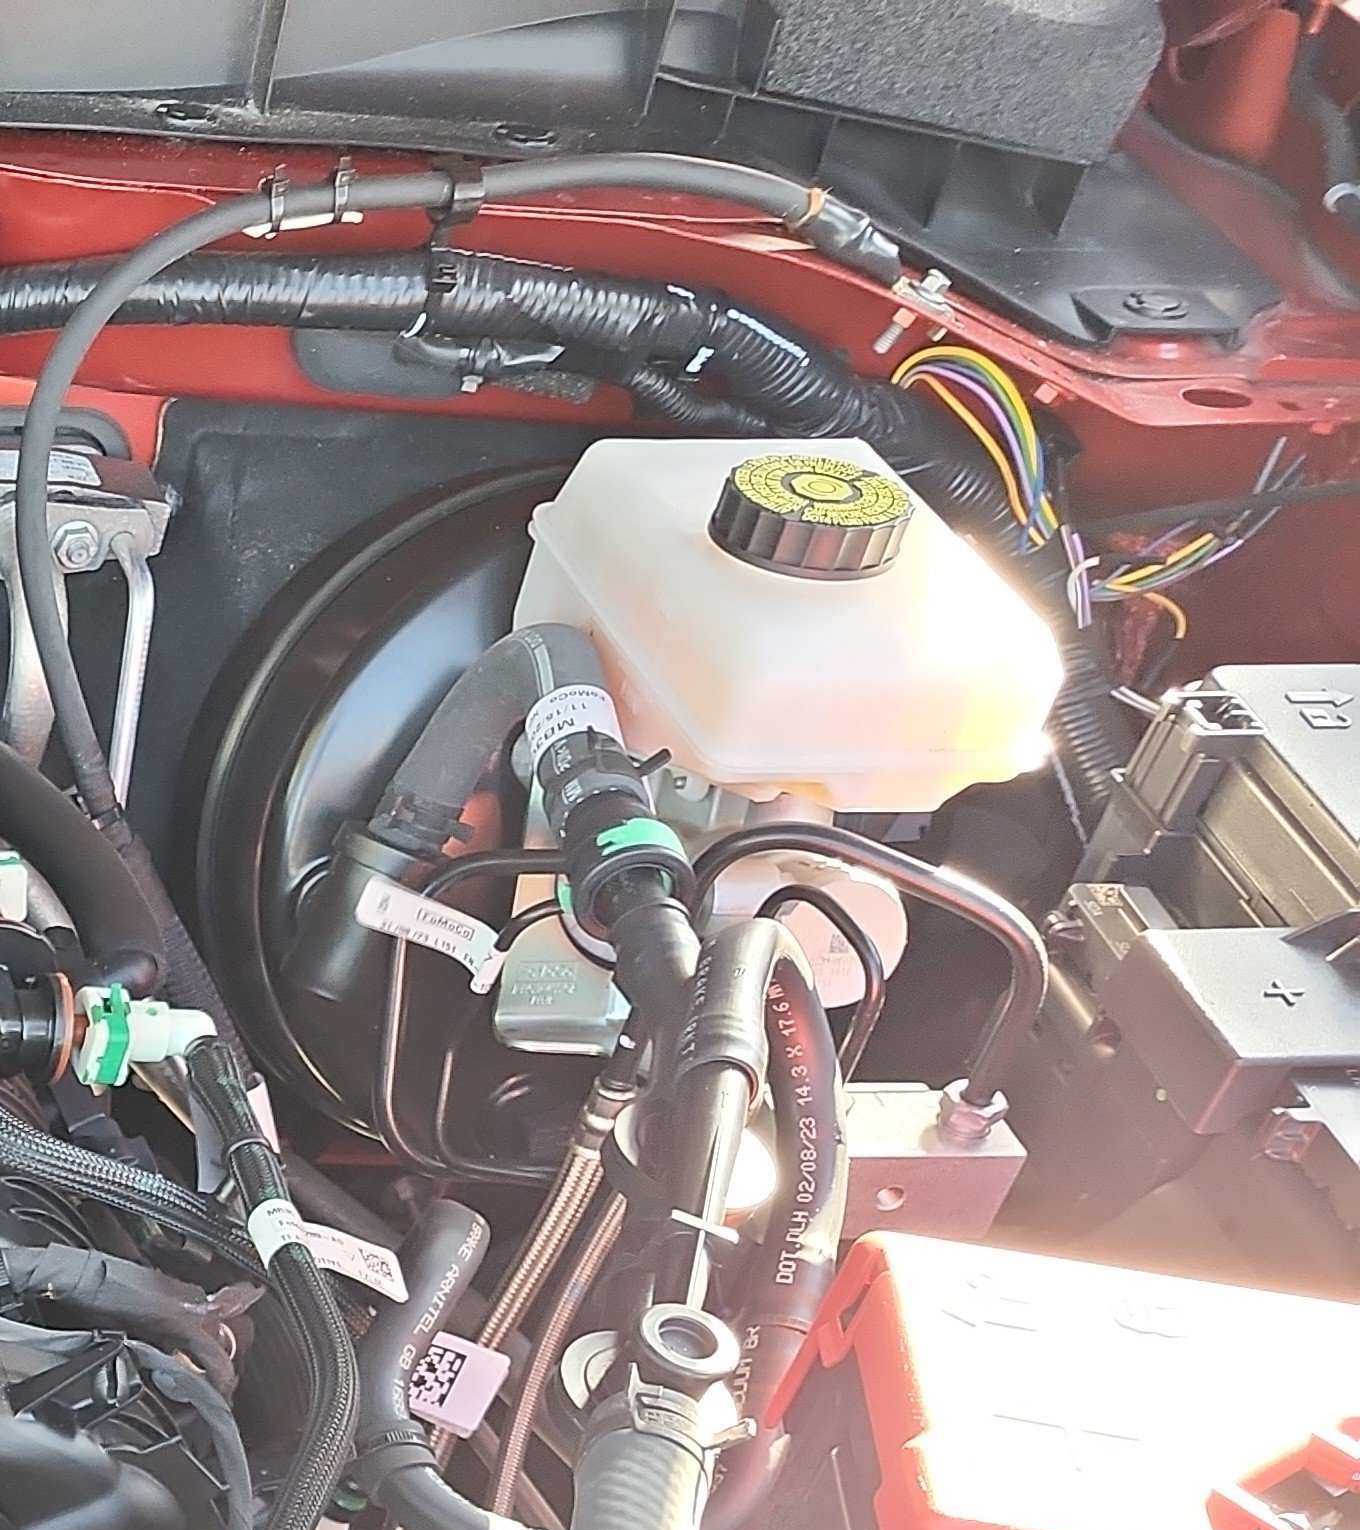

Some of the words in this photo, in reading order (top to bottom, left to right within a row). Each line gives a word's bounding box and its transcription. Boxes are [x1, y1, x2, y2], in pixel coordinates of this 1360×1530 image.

[791, 1065, 813, 1106] 14.3
[796, 1116, 818, 1203] 02/08/23
[458, 1221, 483, 1262] BRAKE
[413, 1263, 460, 1335] ARNITEL
[399, 1343, 417, 1371] GB
